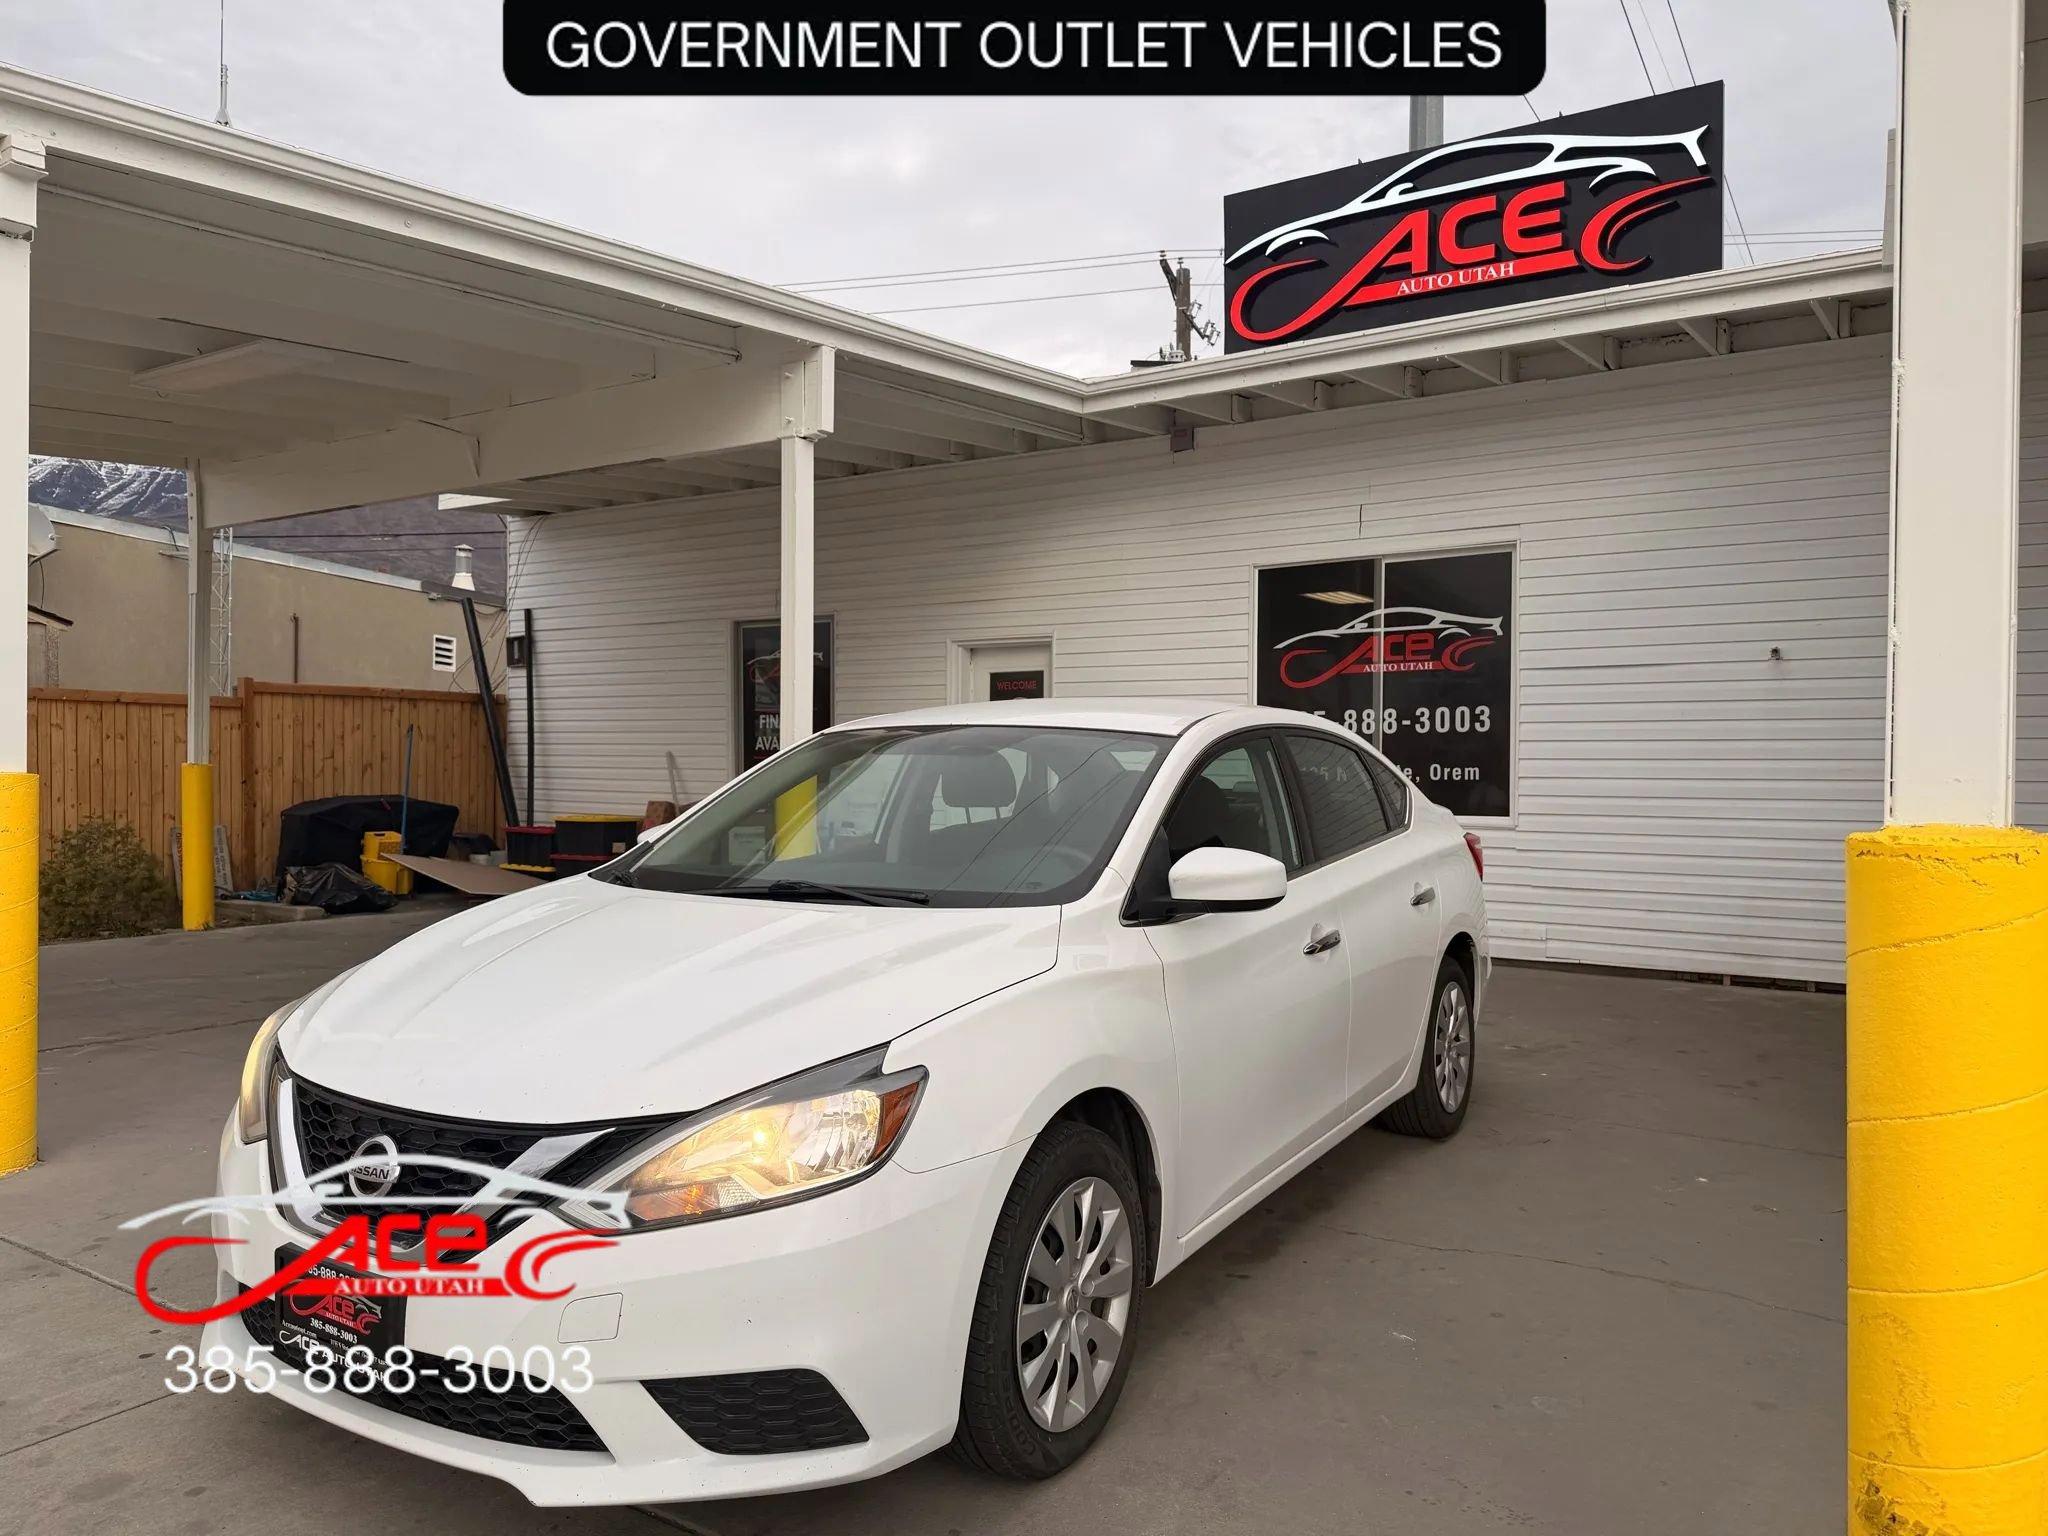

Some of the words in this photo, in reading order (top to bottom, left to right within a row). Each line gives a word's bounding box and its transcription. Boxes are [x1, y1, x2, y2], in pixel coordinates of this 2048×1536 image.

[1335, 180, 1567, 300] ACE
[1397, 273, 1453, 296] AUTO
[1458, 262, 1515, 285] UTAH
[1362, 662, 1398, 673] AUTO
[1400, 661, 1433, 672] UTAH
[996, 680, 1037, 690] WELCOME
[1429, 763, 1481, 781] Orem
[351, 1165, 390, 1180] SSAN
[309, 1316, 358, 1345] 385-888-3003
